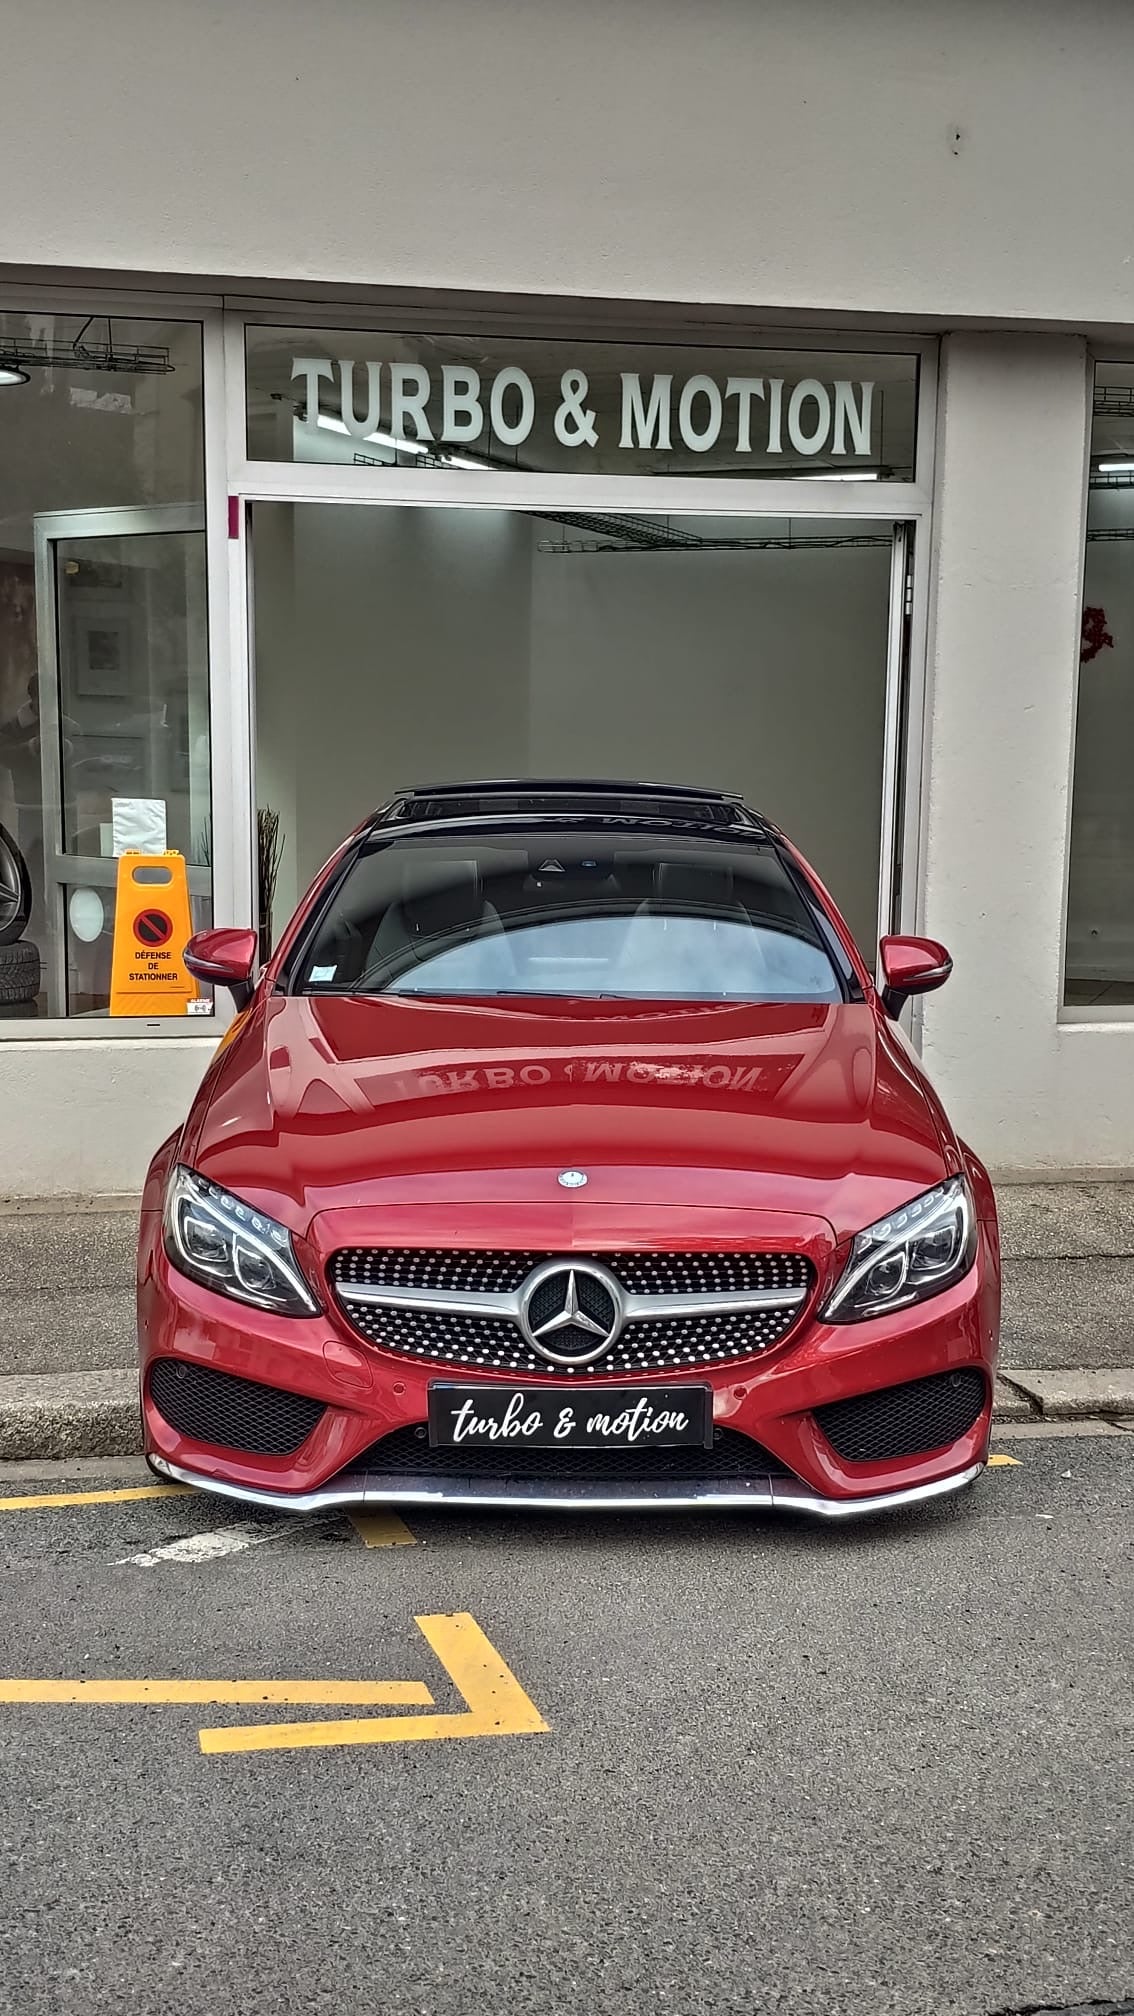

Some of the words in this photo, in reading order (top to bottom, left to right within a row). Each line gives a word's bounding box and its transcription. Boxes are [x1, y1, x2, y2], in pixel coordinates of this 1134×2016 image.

[291, 358, 535, 446] TURBO
[553, 368, 599, 448] &
[618, 373, 875, 455] MOTION
[135, 950, 172, 960] DÉFENSE
[148, 962, 159, 970] DE
[129, 973, 178, 981] STATIONNER
[451, 1392, 543, 1442] turbo
[553, 1407, 576, 1438] &
[586, 1397, 689, 1441] motion
